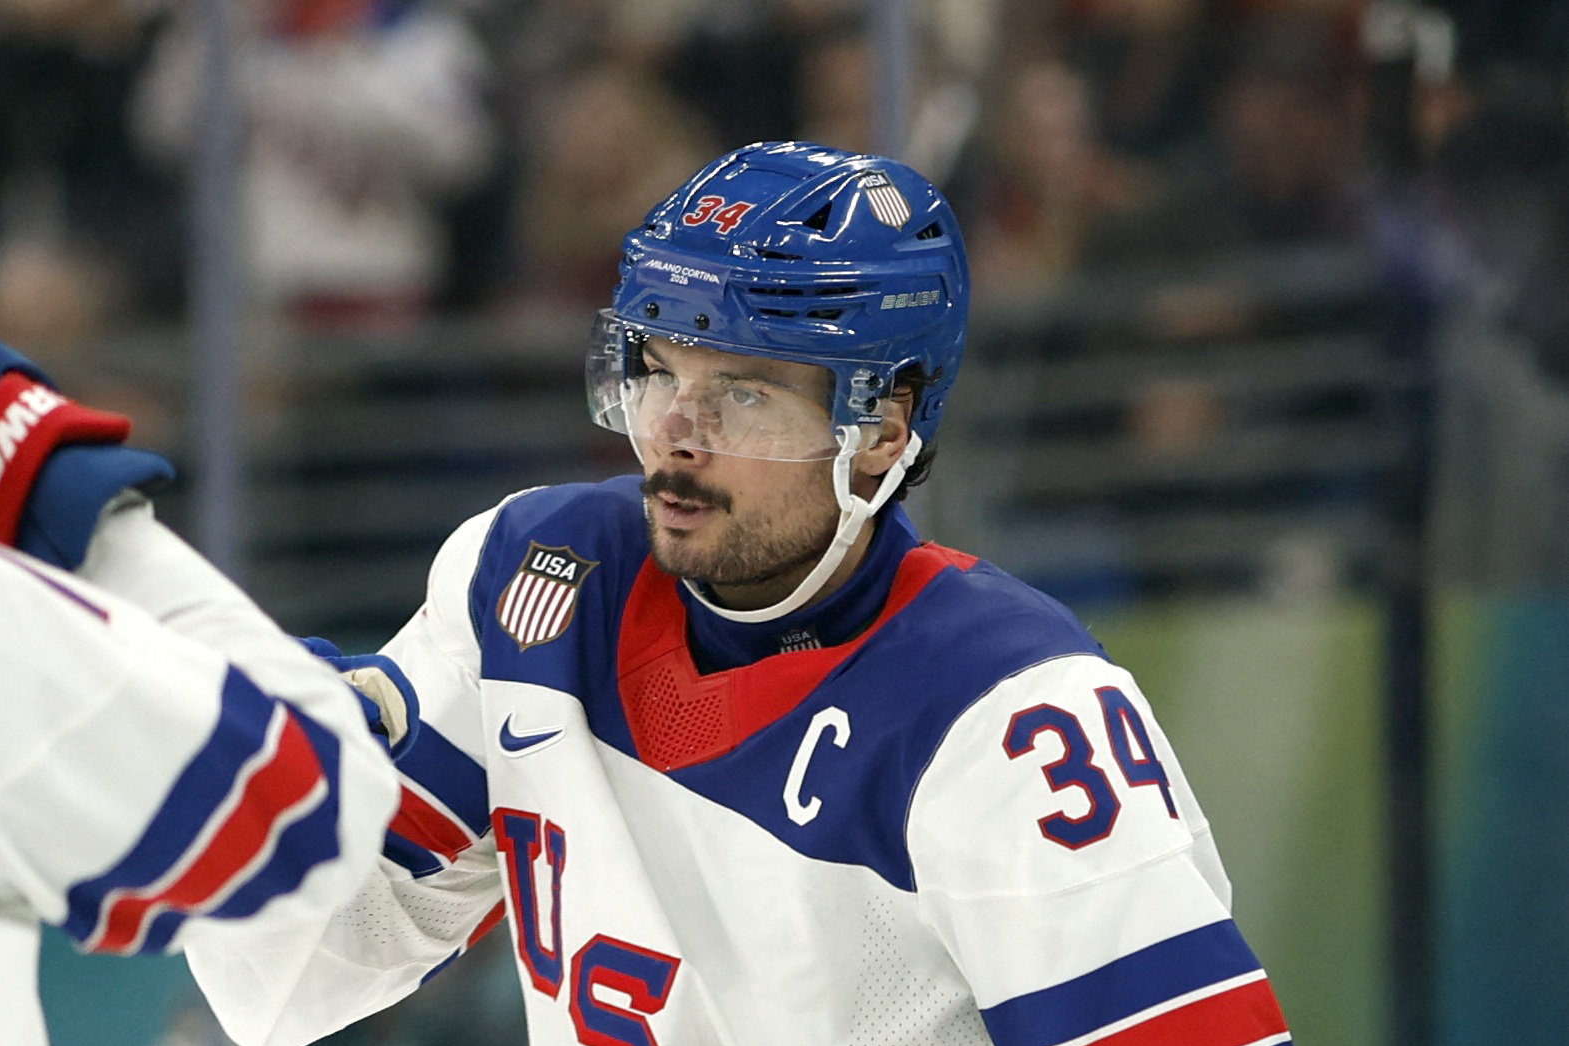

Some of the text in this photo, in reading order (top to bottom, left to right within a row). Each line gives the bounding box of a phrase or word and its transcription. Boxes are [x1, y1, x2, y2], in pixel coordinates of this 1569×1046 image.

[864, 173, 889, 188] USA
[682, 195, 757, 235] 34
[645, 259, 720, 284] MILANO CORTINA
[669, 273, 689, 286] 2026
[880, 290, 941, 310] BAUER
[531, 551, 576, 580] USA
[783, 631, 810, 644] USA
[783, 706, 851, 826] C
[1002, 685, 1180, 851] 34
